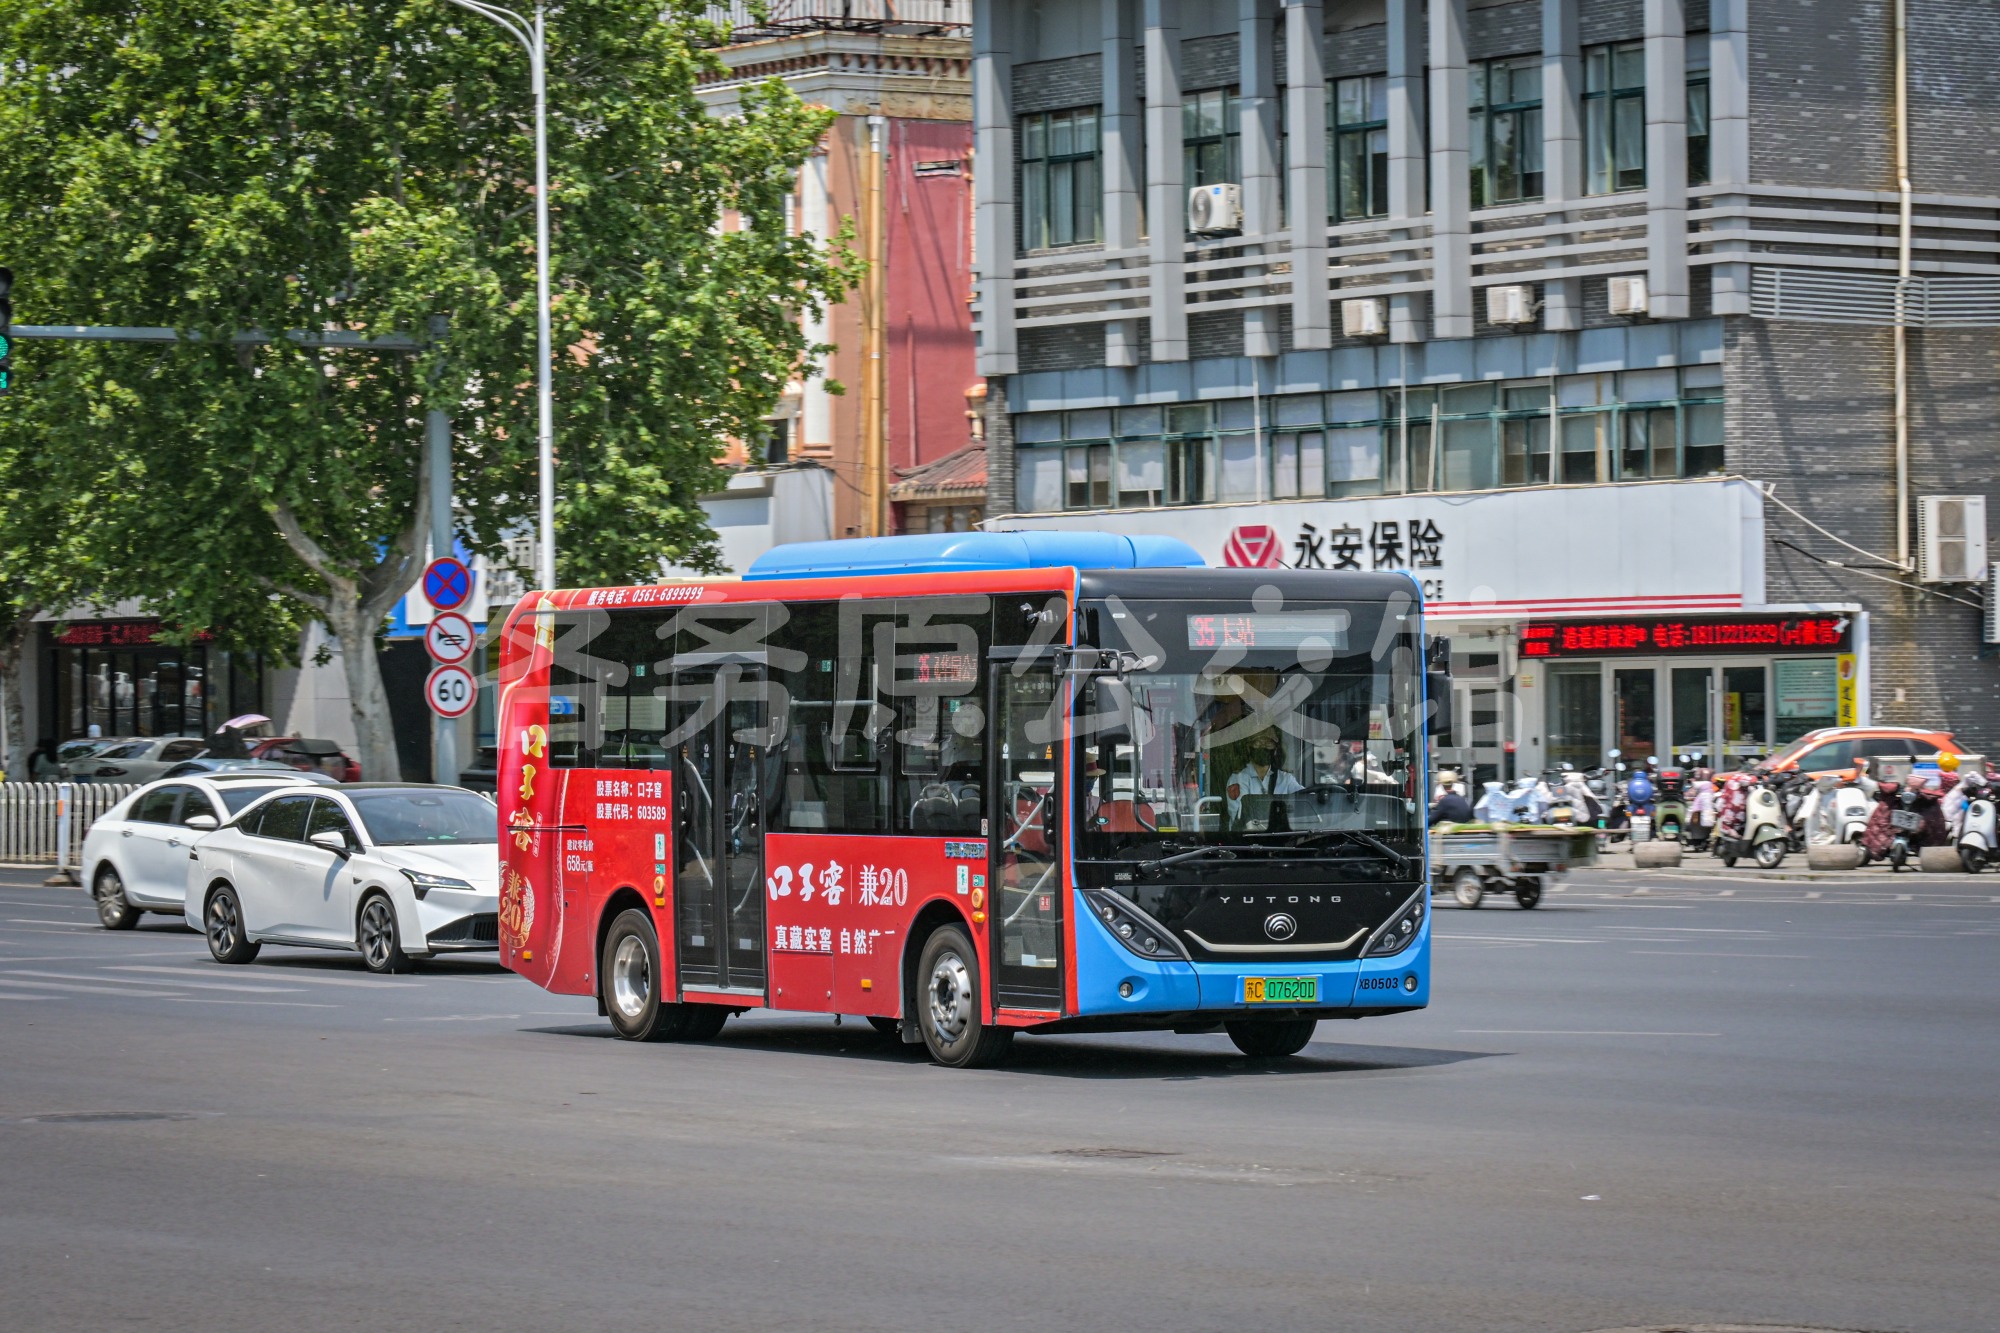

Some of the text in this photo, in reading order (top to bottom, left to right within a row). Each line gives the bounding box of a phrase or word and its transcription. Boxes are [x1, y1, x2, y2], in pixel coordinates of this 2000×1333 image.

[1294, 518, 1443, 569] 永安保险
[1195, 617, 1215, 646] 35
[438, 679, 465, 702] 60
[767, 860, 845, 906] 口子窖
[1219, 895, 1342, 904] YUTONG
[775, 925, 833, 951] 真藏实窖
[1359, 977, 1399, 990] XB0503
